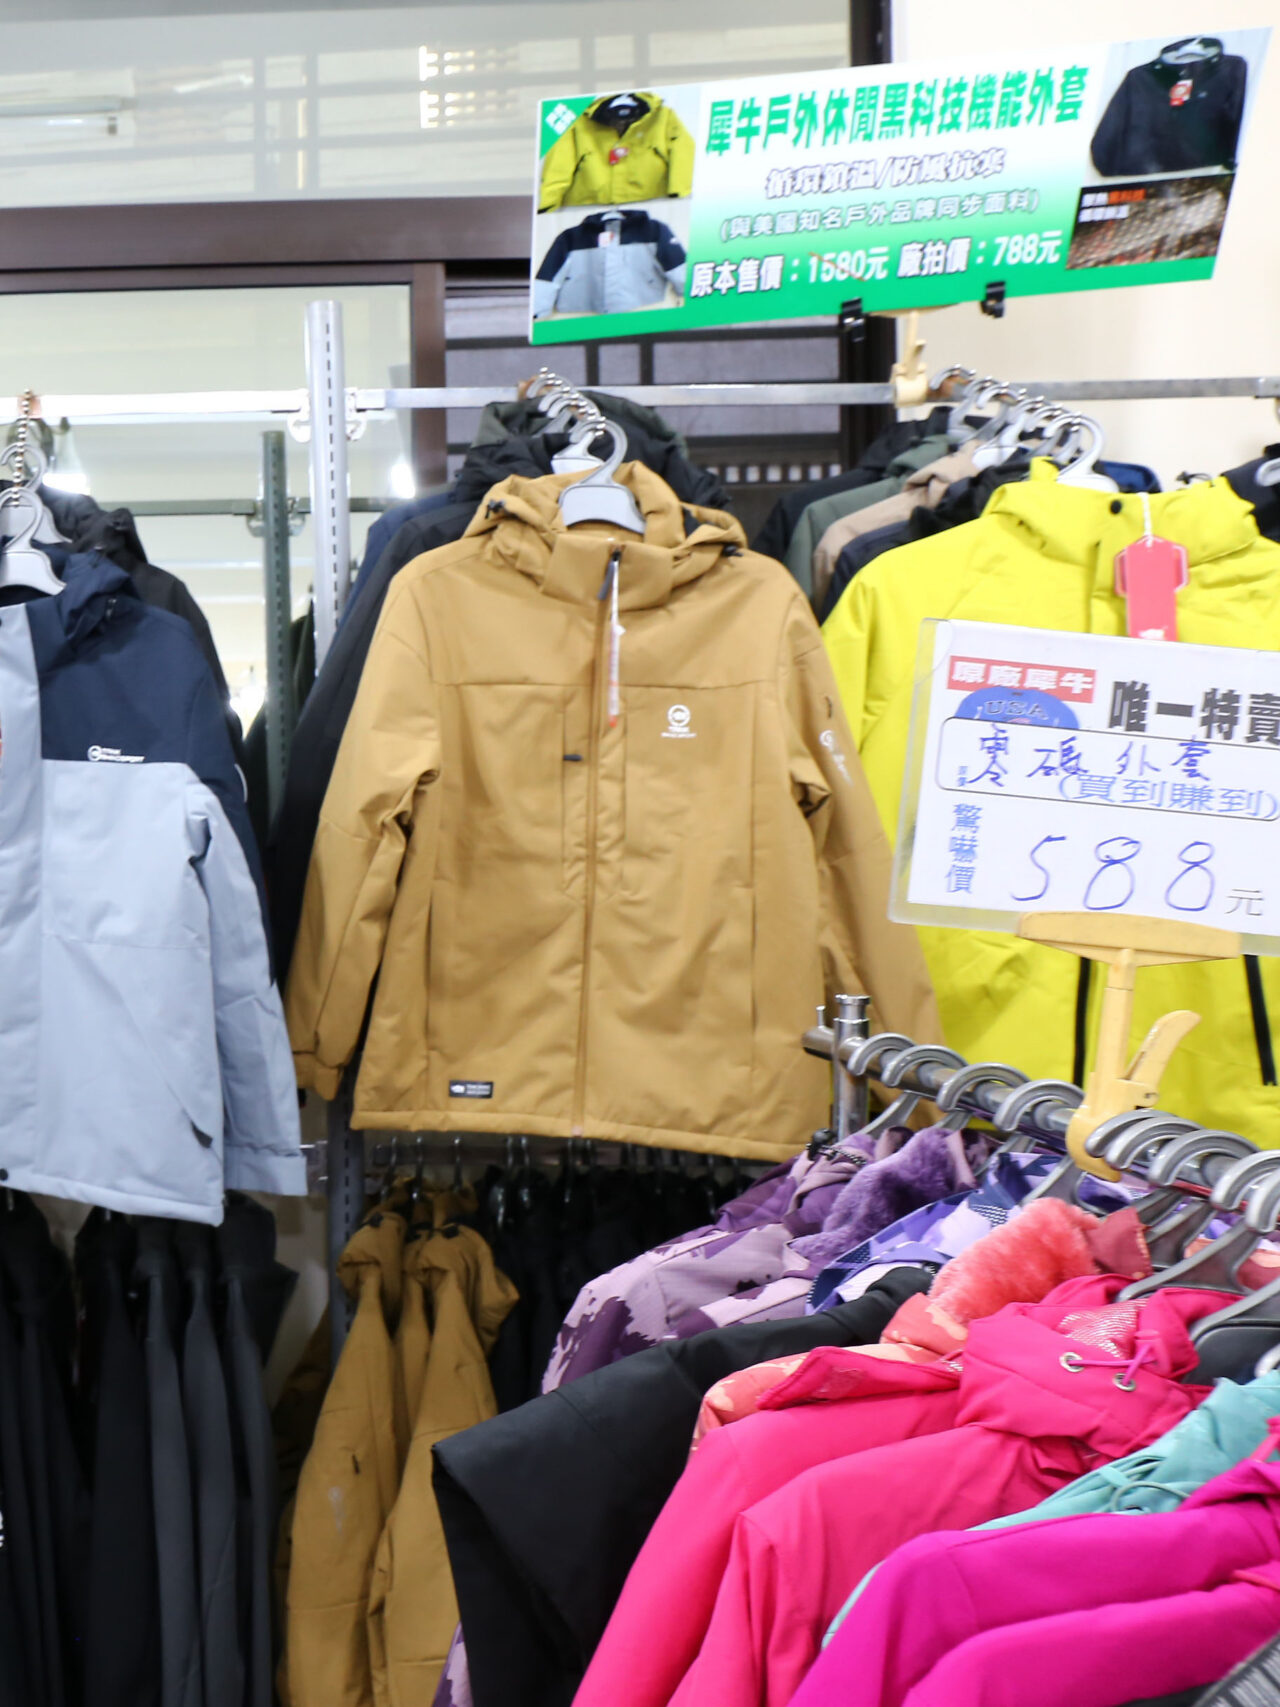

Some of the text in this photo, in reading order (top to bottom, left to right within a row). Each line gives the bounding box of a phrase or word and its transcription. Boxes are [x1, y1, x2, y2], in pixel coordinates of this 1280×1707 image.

[952, 661, 1094, 694] 原廠犀牛
[984, 700, 1049, 721] USA
[1011, 836, 1216, 912] 588
[1226, 888, 1265, 916] 元
